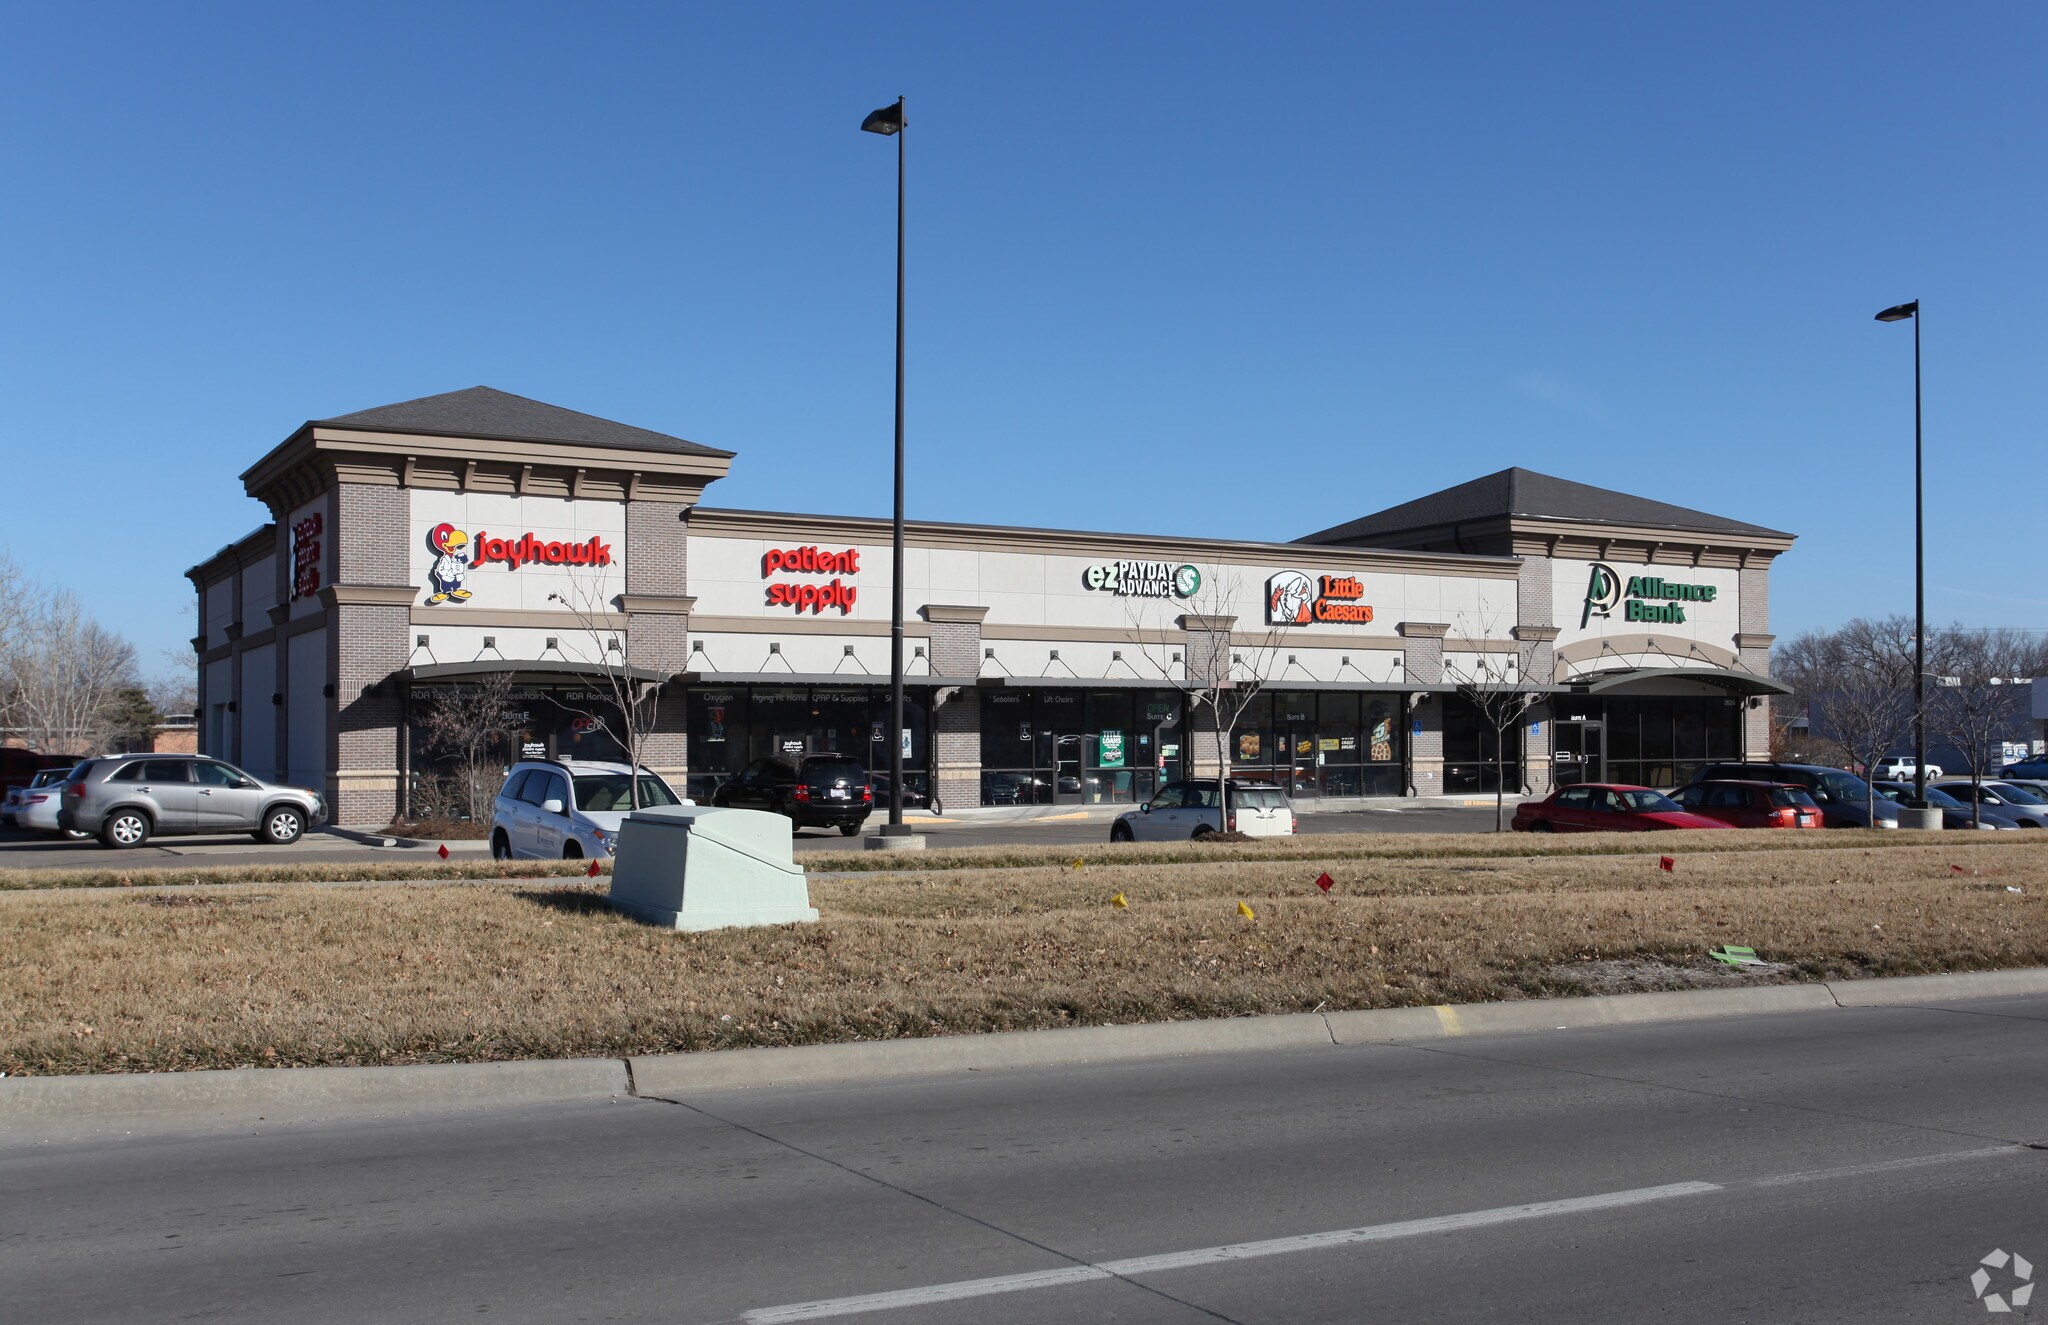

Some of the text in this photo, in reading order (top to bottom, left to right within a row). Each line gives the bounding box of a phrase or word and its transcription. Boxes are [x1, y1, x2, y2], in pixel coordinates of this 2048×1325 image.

[473, 530, 612, 568] jayhawk
[765, 545, 860, 576] patient
[1087, 561, 1175, 589] ez PAYDAY
[1118, 579, 1176, 596] ADVANCE
[1323, 575, 1364, 598] Little
[1628, 576, 1717, 600] Alliance
[770, 578, 857, 613] supply
[1315, 598, 1373, 622] Caesars
[1629, 600, 1687, 623] Bank
[411, 691, 431, 700] ADA
[566, 692, 614, 702] ADA Ramps
[703, 692, 734, 703] Oxygen
[752, 693, 774, 703] Aging
[786, 693, 808, 701] Home
[840, 694, 869, 703] Supplies
[992, 695, 1020, 703] Scooters
[1043, 695, 1074, 703] Lift Chairs
[1102, 730, 1122, 738] TITLE
